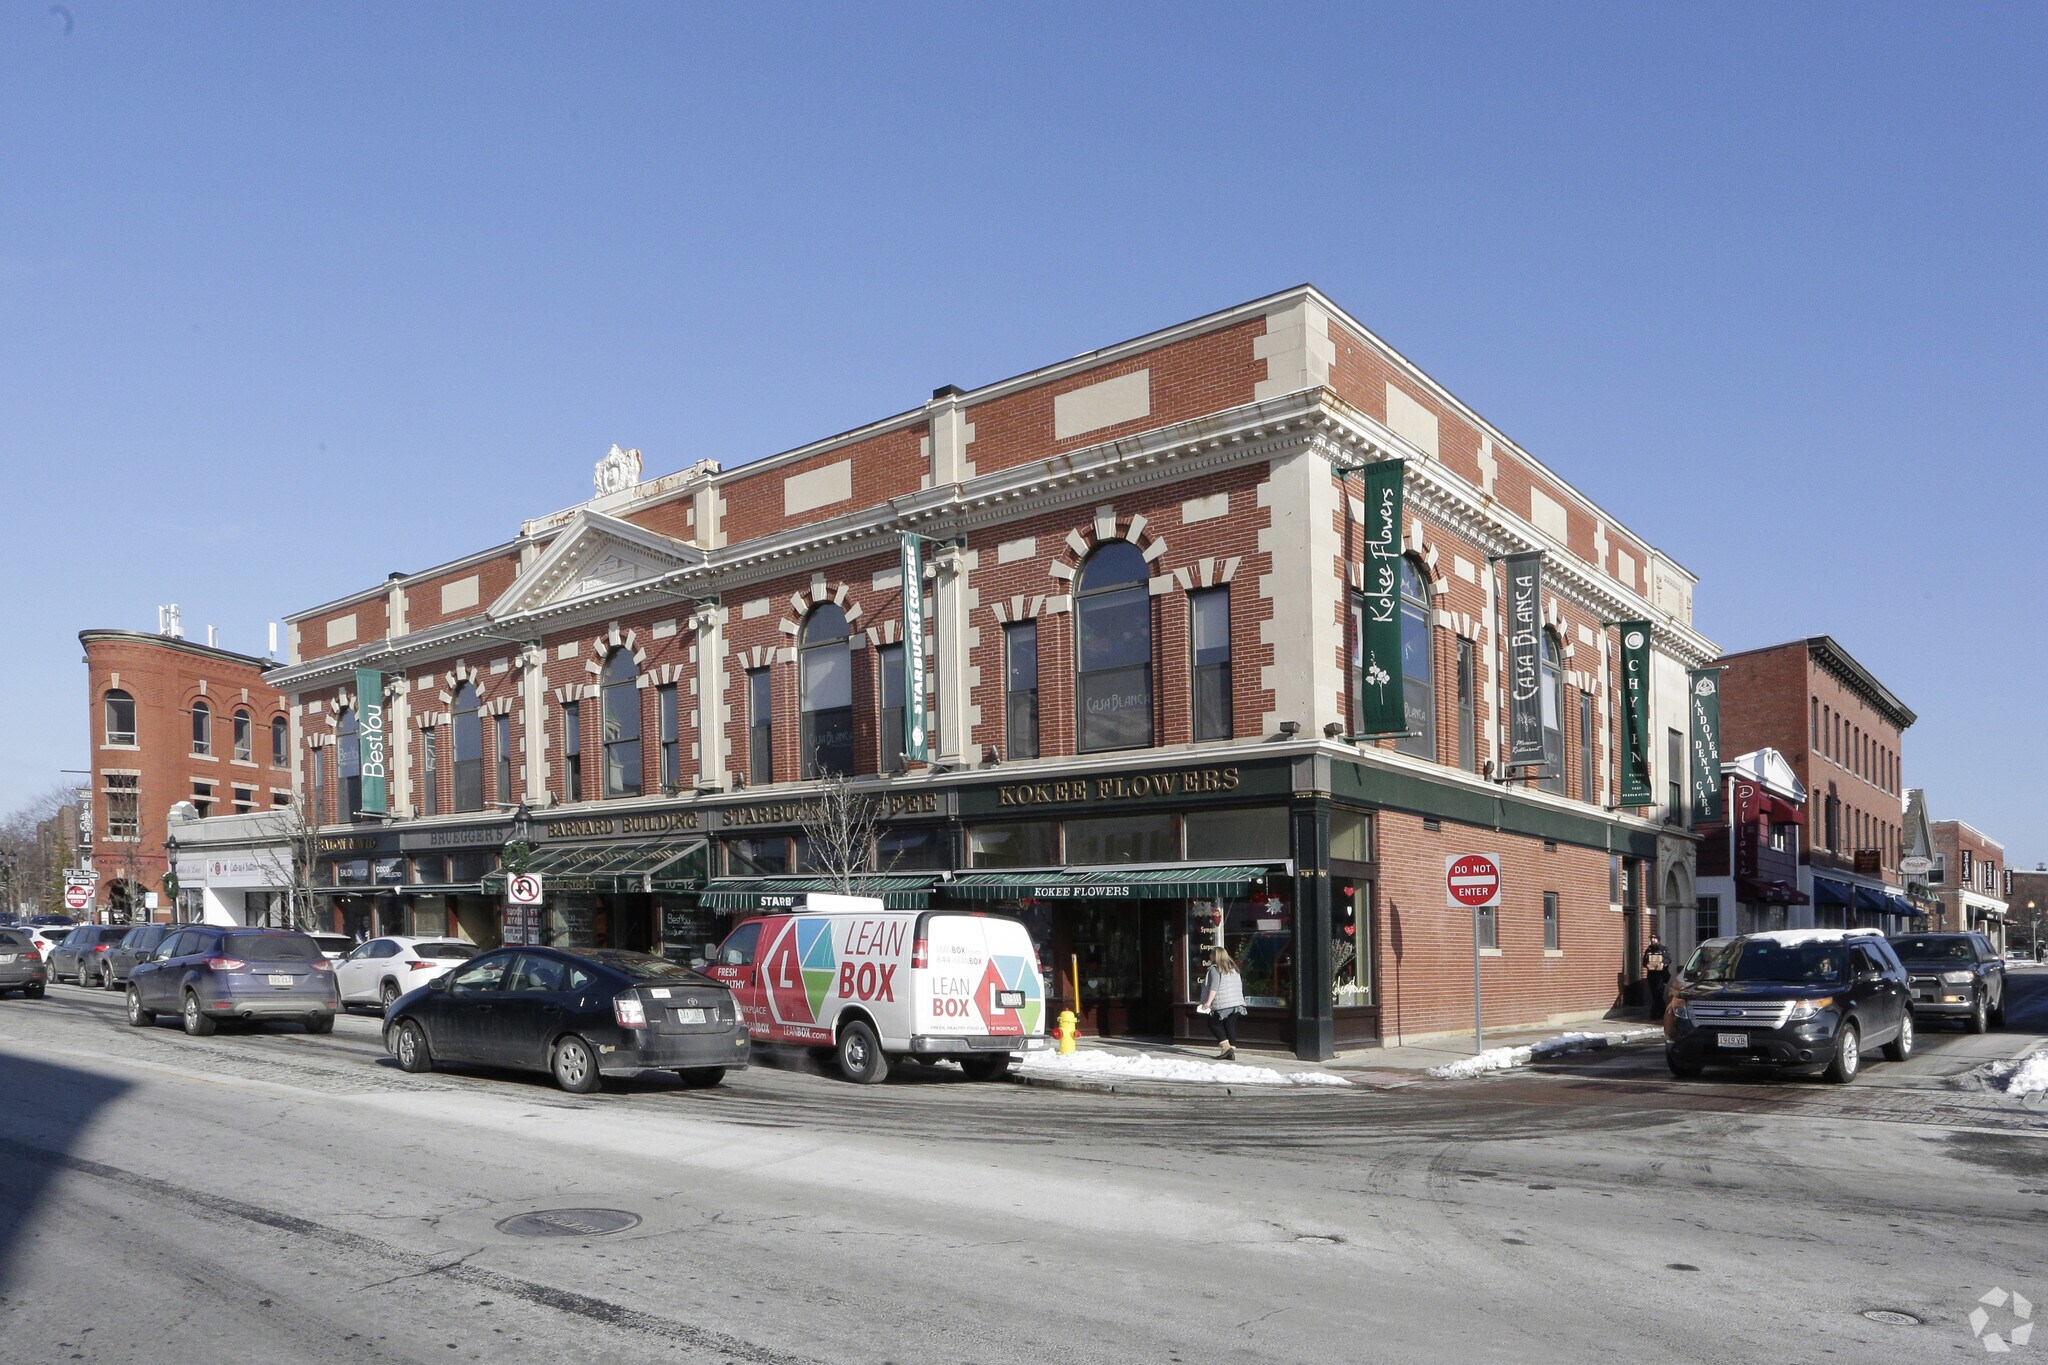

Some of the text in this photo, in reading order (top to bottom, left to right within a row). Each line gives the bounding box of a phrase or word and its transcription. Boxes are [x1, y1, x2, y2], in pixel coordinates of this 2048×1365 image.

[1364, 488, 1398, 622] Kokee Flowers
[1512, 575, 1539, 700] CASA BLANCA
[910, 612, 923, 715] STARBUCKS
[360, 704, 384, 778] BestYou
[1694, 699, 1718, 759] ANDOVER
[1695, 740, 1718, 792] DENTAL
[998, 767, 1239, 806] KOKEE FLOWERS
[1696, 781, 1711, 816] CARE
[858, 792, 937, 818] FFEE
[547, 811, 699, 838] BARNARD BUILDING
[1454, 864, 1491, 874] DO NOT
[760, 896, 794, 907] STARB
[1034, 886, 1130, 897] KOKEE FLOWERS
[1458, 887, 1489, 897] ENTER
[844, 920, 908, 956] LEAN
[717, 967, 738, 977] FRESH
[838, 961, 898, 1003] BOX
[932, 976, 970, 996] LEAN
[740, 1005, 767, 1015] RKPLACE
[932, 997, 970, 1018] BOX
[745, 1022, 770, 1034] EANBOX
[783, 1025, 827, 1040] LEANBOX.com
